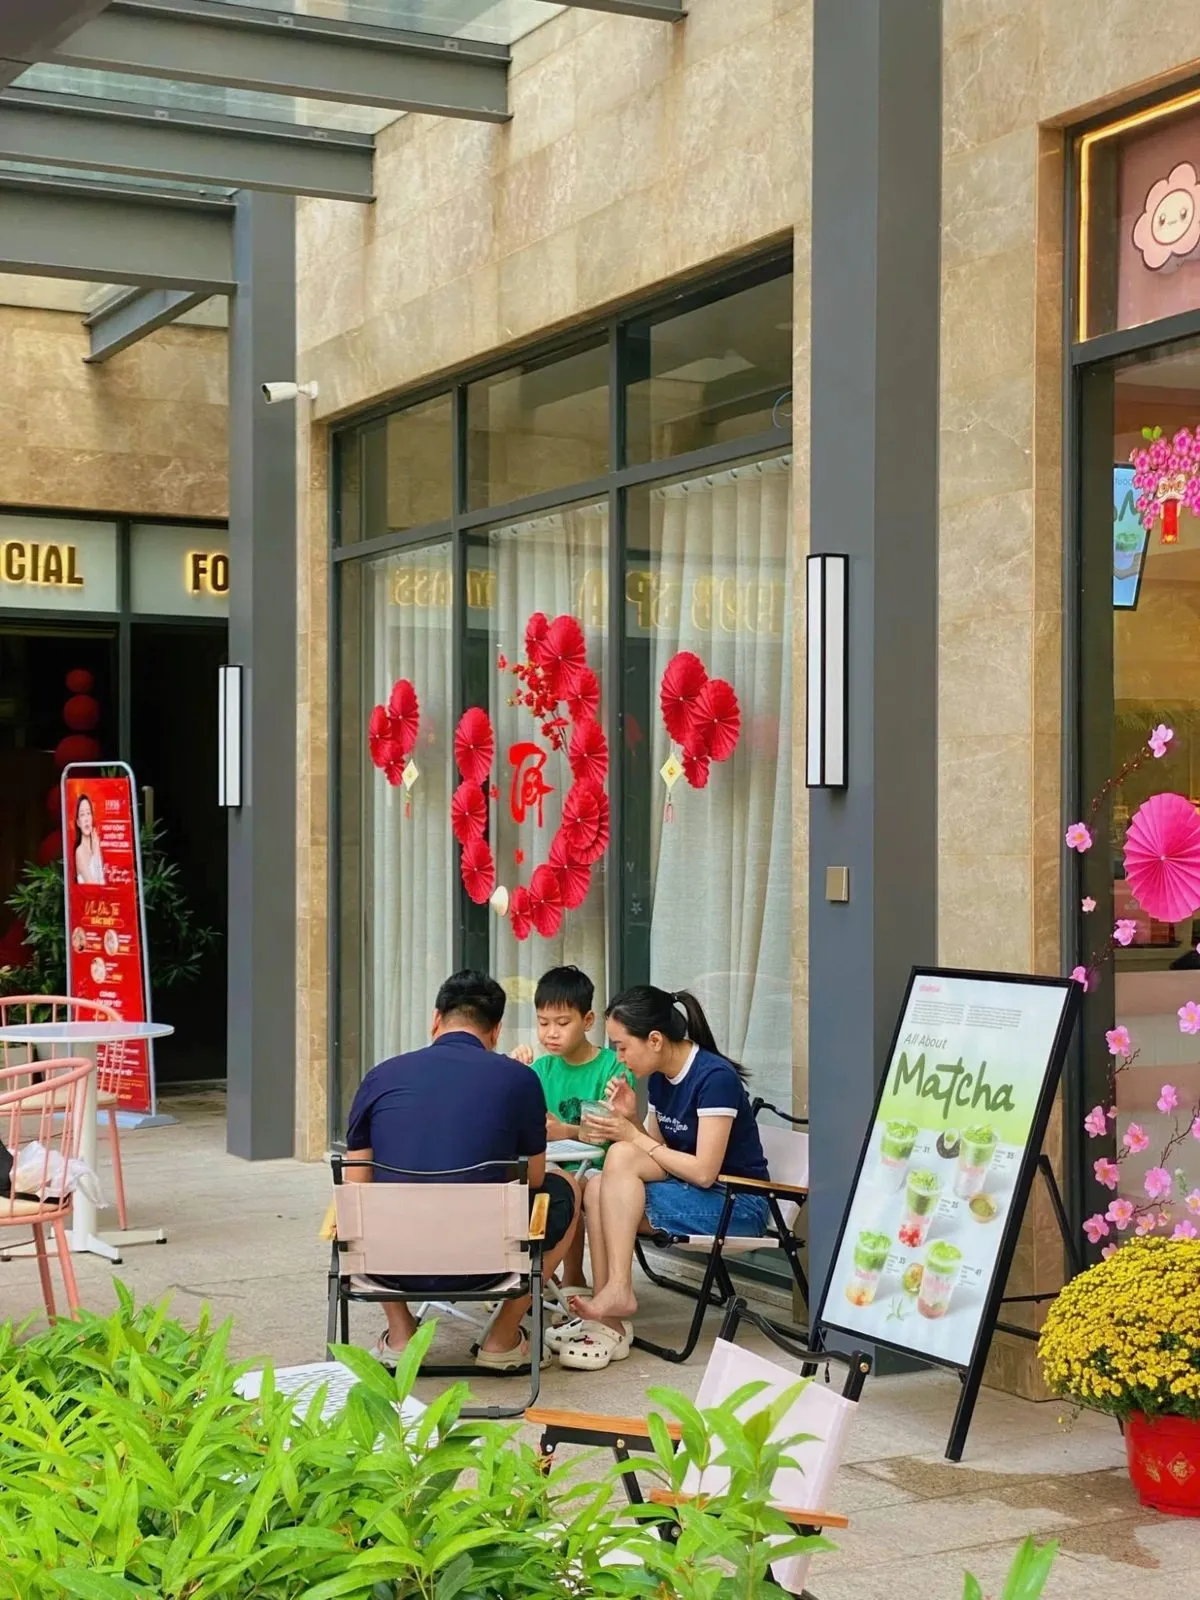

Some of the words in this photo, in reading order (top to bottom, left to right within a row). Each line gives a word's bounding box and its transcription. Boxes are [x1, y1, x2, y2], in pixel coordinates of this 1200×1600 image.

[5, 542, 84, 585] CIAL
[904, 1032, 919, 1045] All
[919, 1034, 947, 1049] About
[892, 1051, 1015, 1120] Matcha
